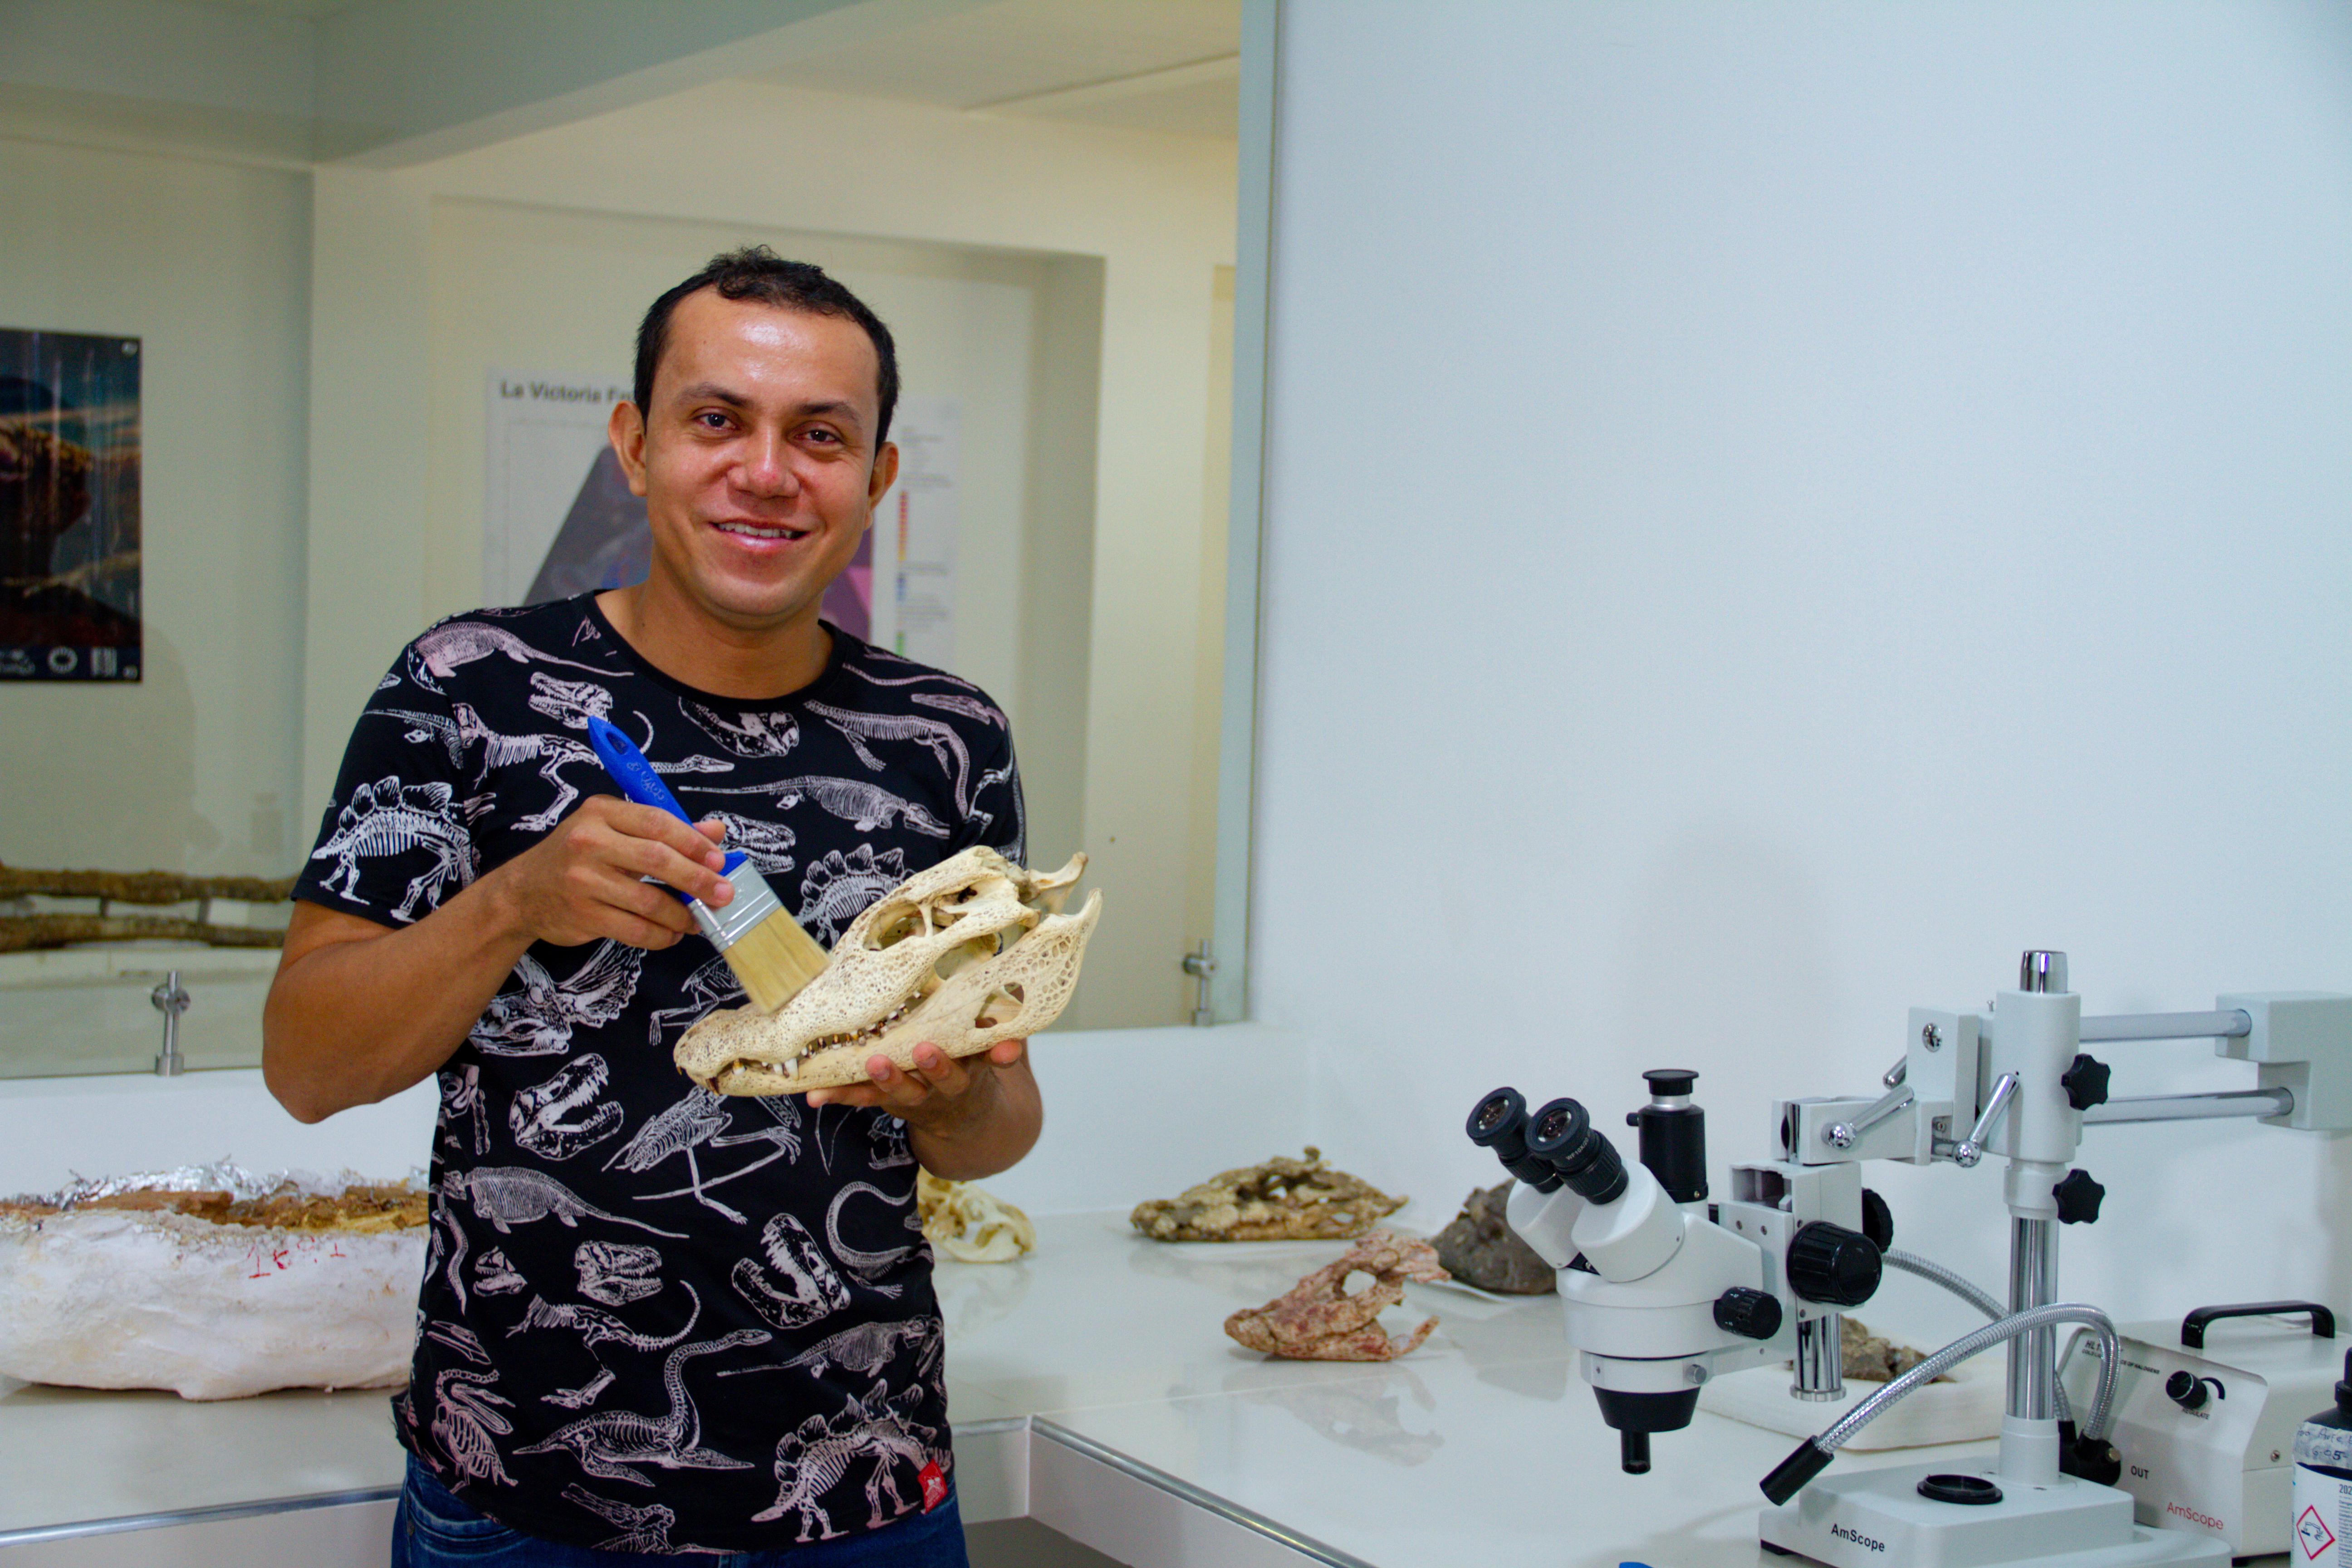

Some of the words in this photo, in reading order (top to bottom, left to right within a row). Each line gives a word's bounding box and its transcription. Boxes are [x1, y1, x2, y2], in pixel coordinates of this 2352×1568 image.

[500, 380, 523, 398] La
[529, 381, 601, 402] Victoria
[2131, 1465, 2149, 1479] OUT
[2166, 1502, 2223, 1529] AmScope
[1831, 1523, 1885, 1552] AmScope
